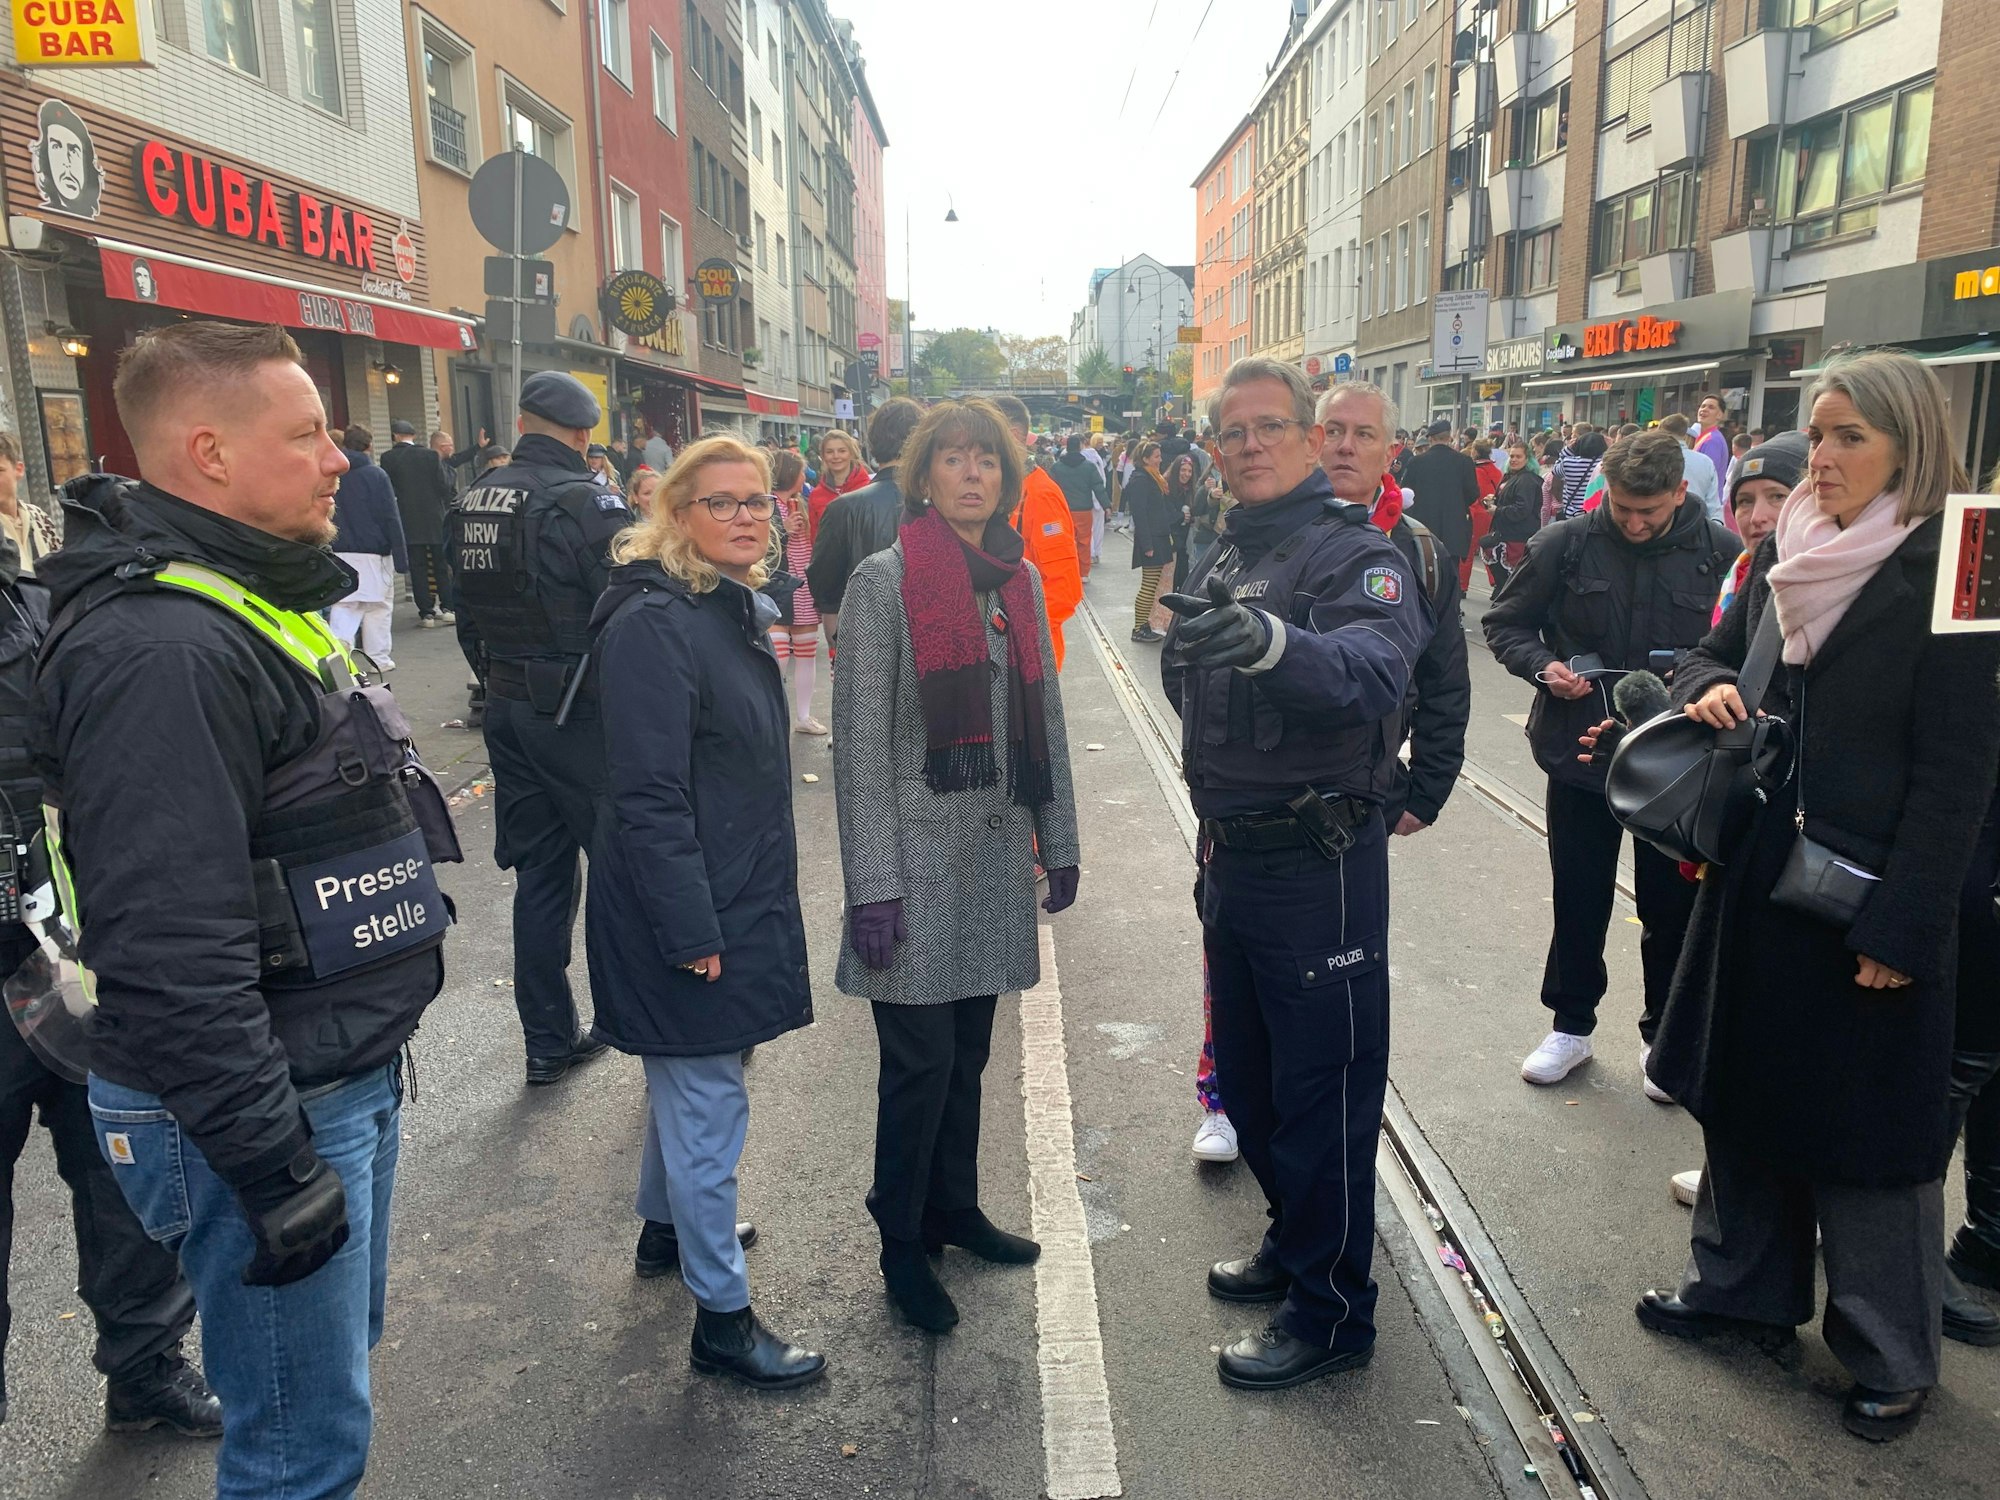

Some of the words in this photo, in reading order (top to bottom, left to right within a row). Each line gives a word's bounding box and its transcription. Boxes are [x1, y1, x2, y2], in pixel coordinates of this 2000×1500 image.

[23, 0, 125, 26] CUBA
[39, 31, 114, 57] BAR
[139, 141, 287, 248] CUBA
[298, 193, 377, 272] BAR
[361, 272, 394, 298] Cocktail
[394, 281, 411, 301] Bar
[610, 274, 663, 297] RISTORANTE
[698, 269, 735, 281] SOUL
[703, 283, 732, 296] BAR
[298, 292, 346, 331] CUBA
[344, 301, 376, 336] BAR
[1636, 315, 1676, 350] Bar
[1509, 341, 1542, 368] HOURS
[1566, 345, 1576, 358] Bar
[464, 522, 499, 545] NRW
[462, 548, 494, 570] 2731
[1234, 580, 1270, 600] POLIZEI
[315, 858, 423, 911] Presse-
[353, 900, 426, 948] stelle
[1327, 948, 1364, 971] POLIZEI
